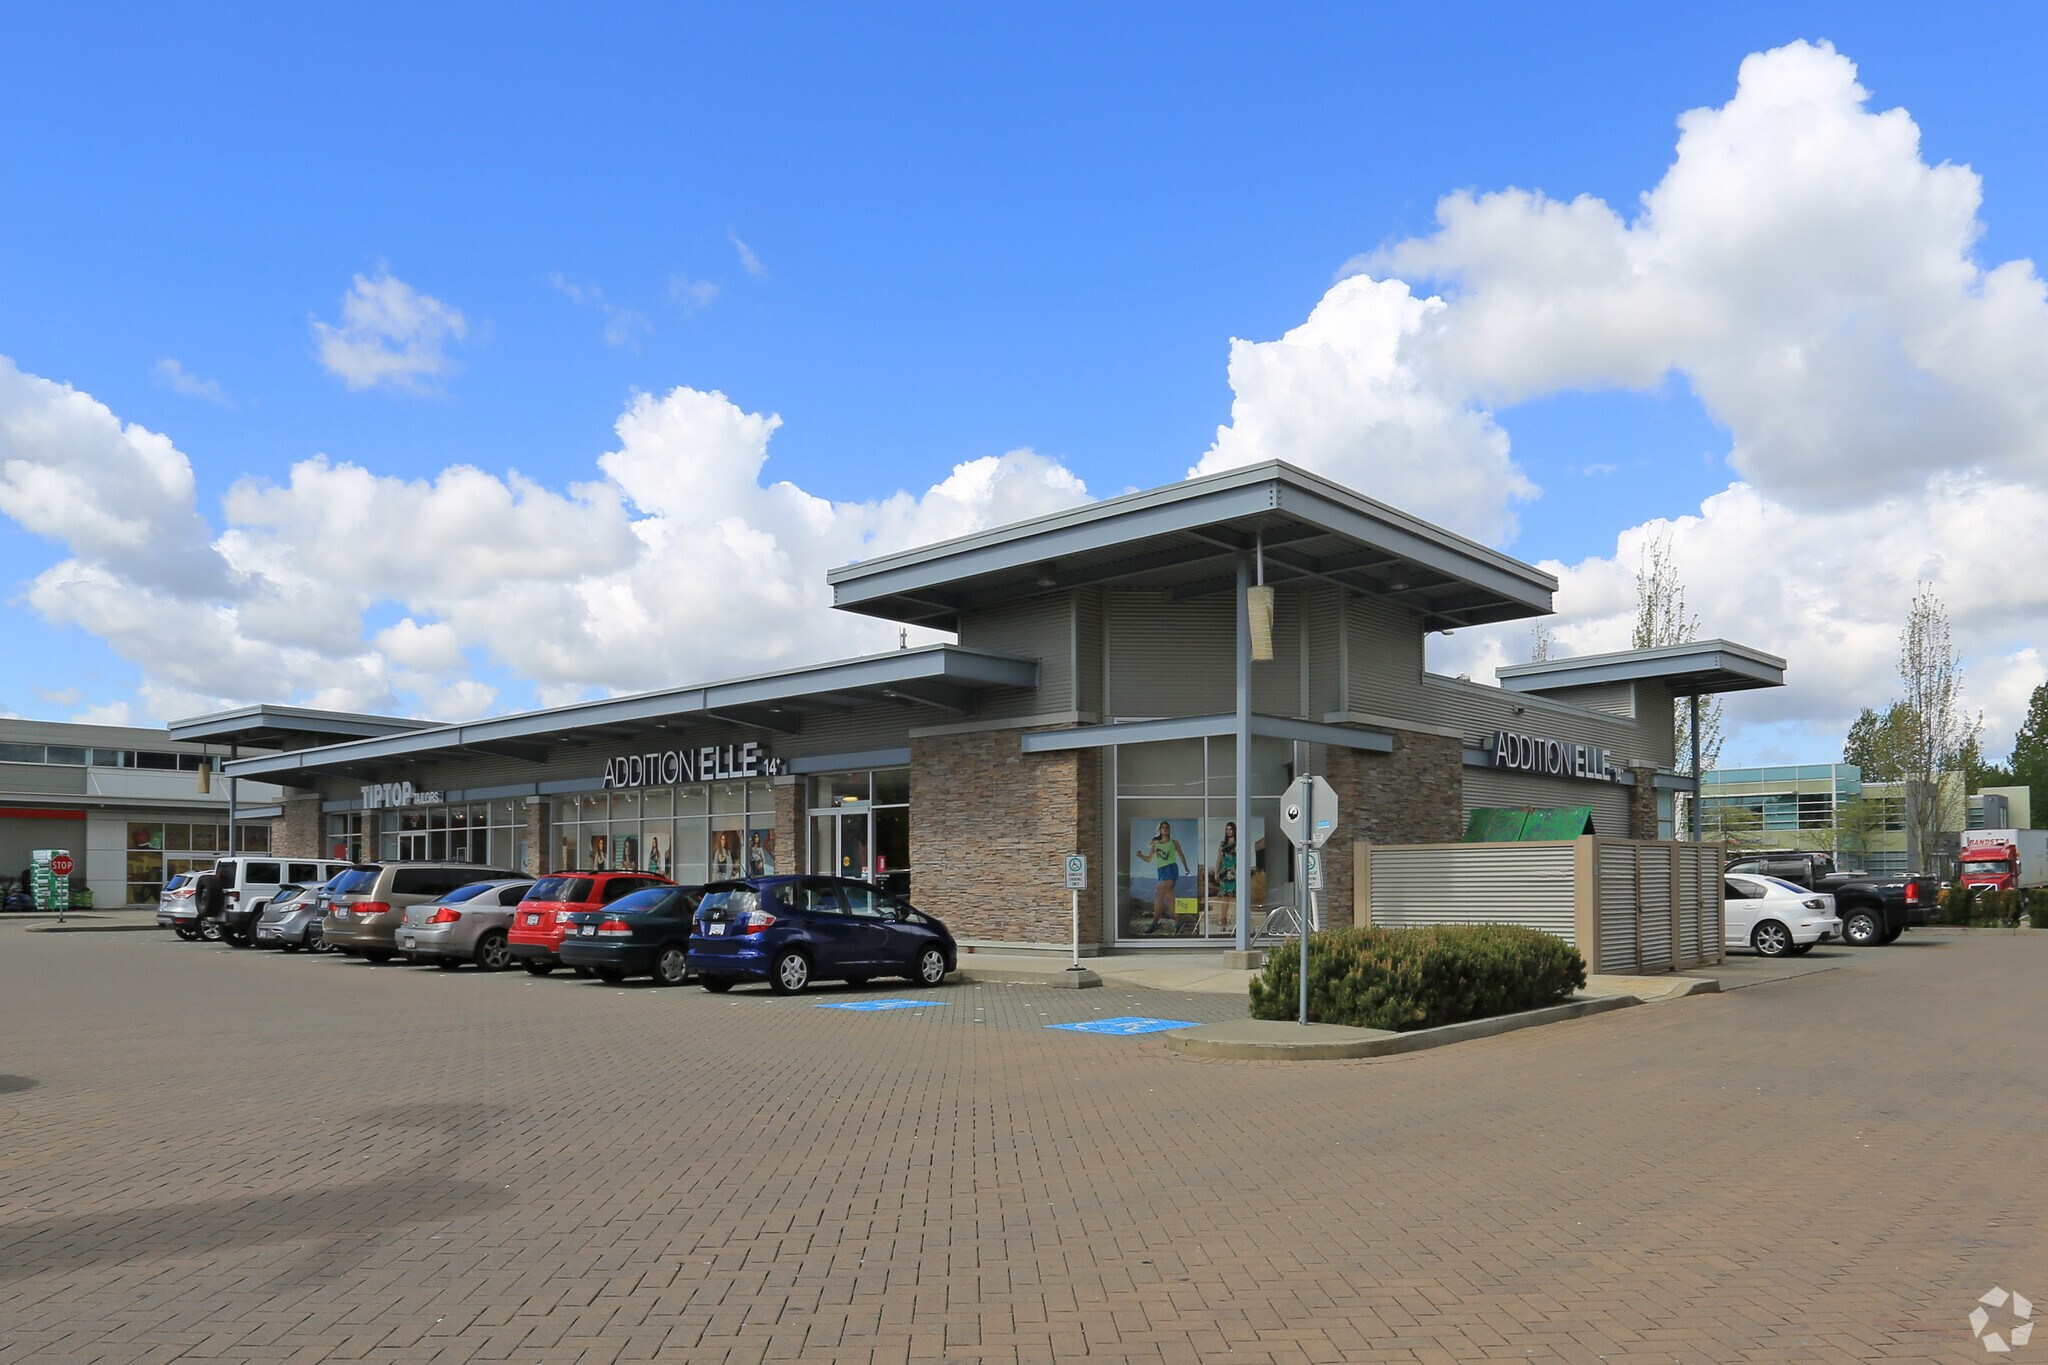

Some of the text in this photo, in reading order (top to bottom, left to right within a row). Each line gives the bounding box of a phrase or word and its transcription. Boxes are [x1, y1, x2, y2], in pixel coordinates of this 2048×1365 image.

[1496, 731, 1571, 775] ADDITION
[1575, 745, 1611, 781] ELLE
[602, 749, 694, 789] ADDITION
[700, 741, 758, 781] ELLE
[413, 791, 439, 805] TAILORS
[1969, 838, 2010, 846] BANDSTA
[52, 861, 73, 870] STOP
